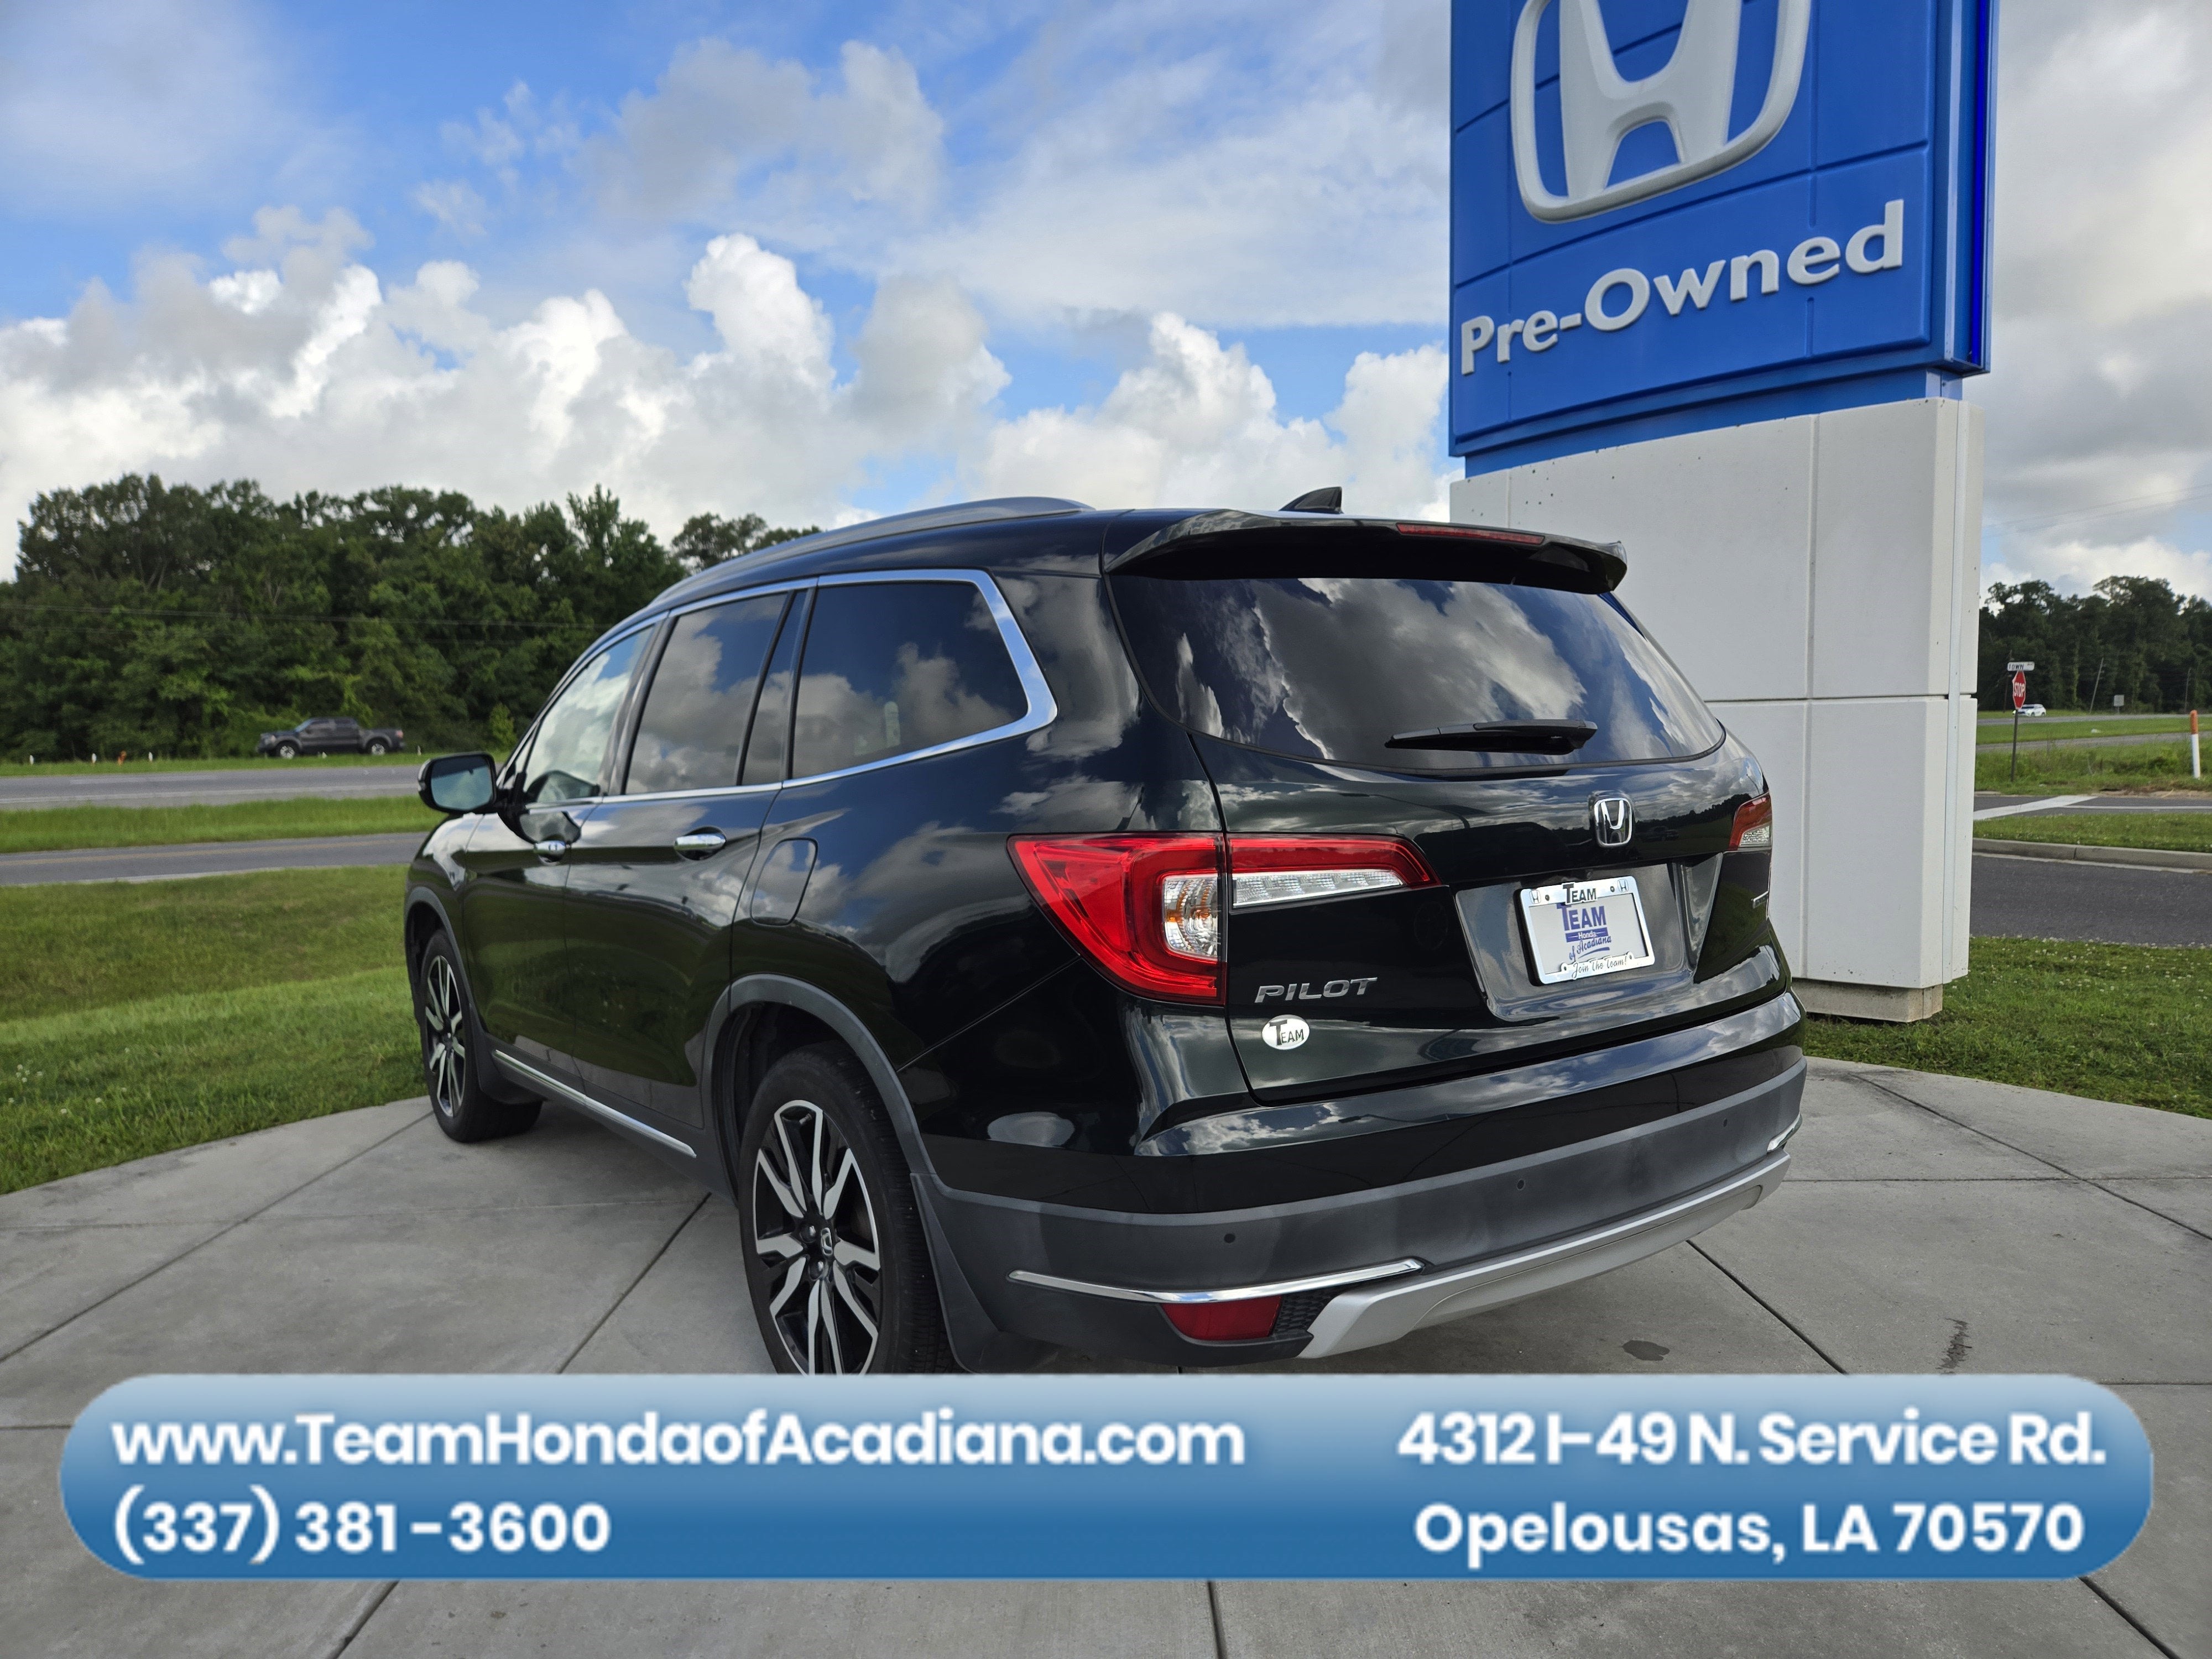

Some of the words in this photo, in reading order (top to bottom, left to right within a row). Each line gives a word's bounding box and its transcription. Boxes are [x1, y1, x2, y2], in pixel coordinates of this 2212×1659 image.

[1460, 199, 1905, 376] Pre-Owned
[2014, 682, 2025, 697] STOP
[1562, 883, 1597, 904] TEAM
[1556, 902, 1606, 931] TEAM
[1578, 931, 1597, 940] Honda
[1569, 946, 1576, 962] of
[1576, 936, 1612, 954] Acadiana
[1572, 962, 1589, 979] Join
[1589, 959, 1604, 972] The
[1604, 955, 1627, 969] Team!
[1254, 977, 1378, 1003] PILOT
[1269, 1019, 1305, 1046] TEAM
